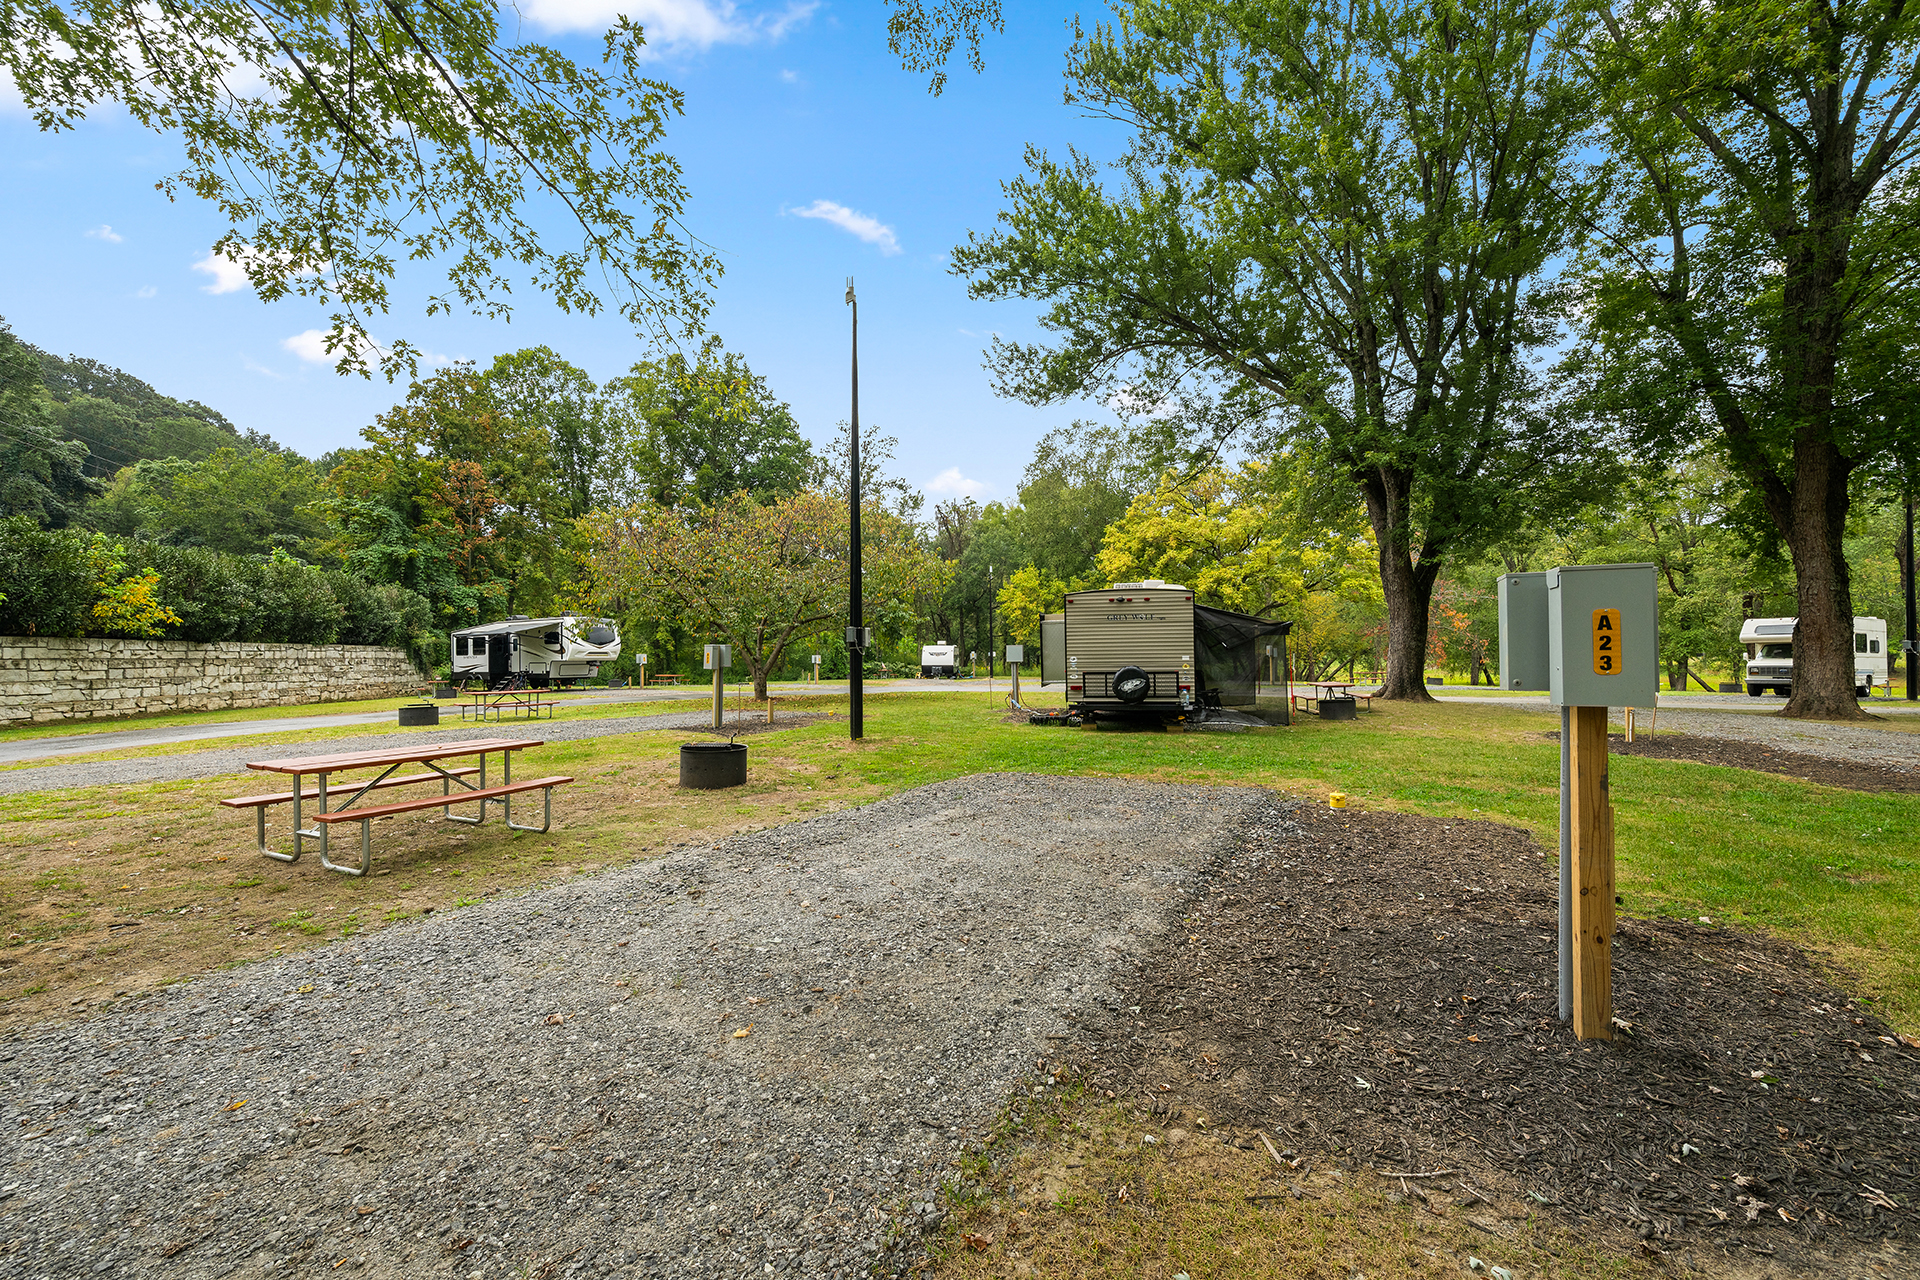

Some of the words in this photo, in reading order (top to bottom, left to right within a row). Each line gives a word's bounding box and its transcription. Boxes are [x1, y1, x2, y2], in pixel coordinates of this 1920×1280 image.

[1106, 613, 1128, 621] GREY
[1131, 613, 1155, 621] WOLF
[1597, 615, 1613, 671] A23
